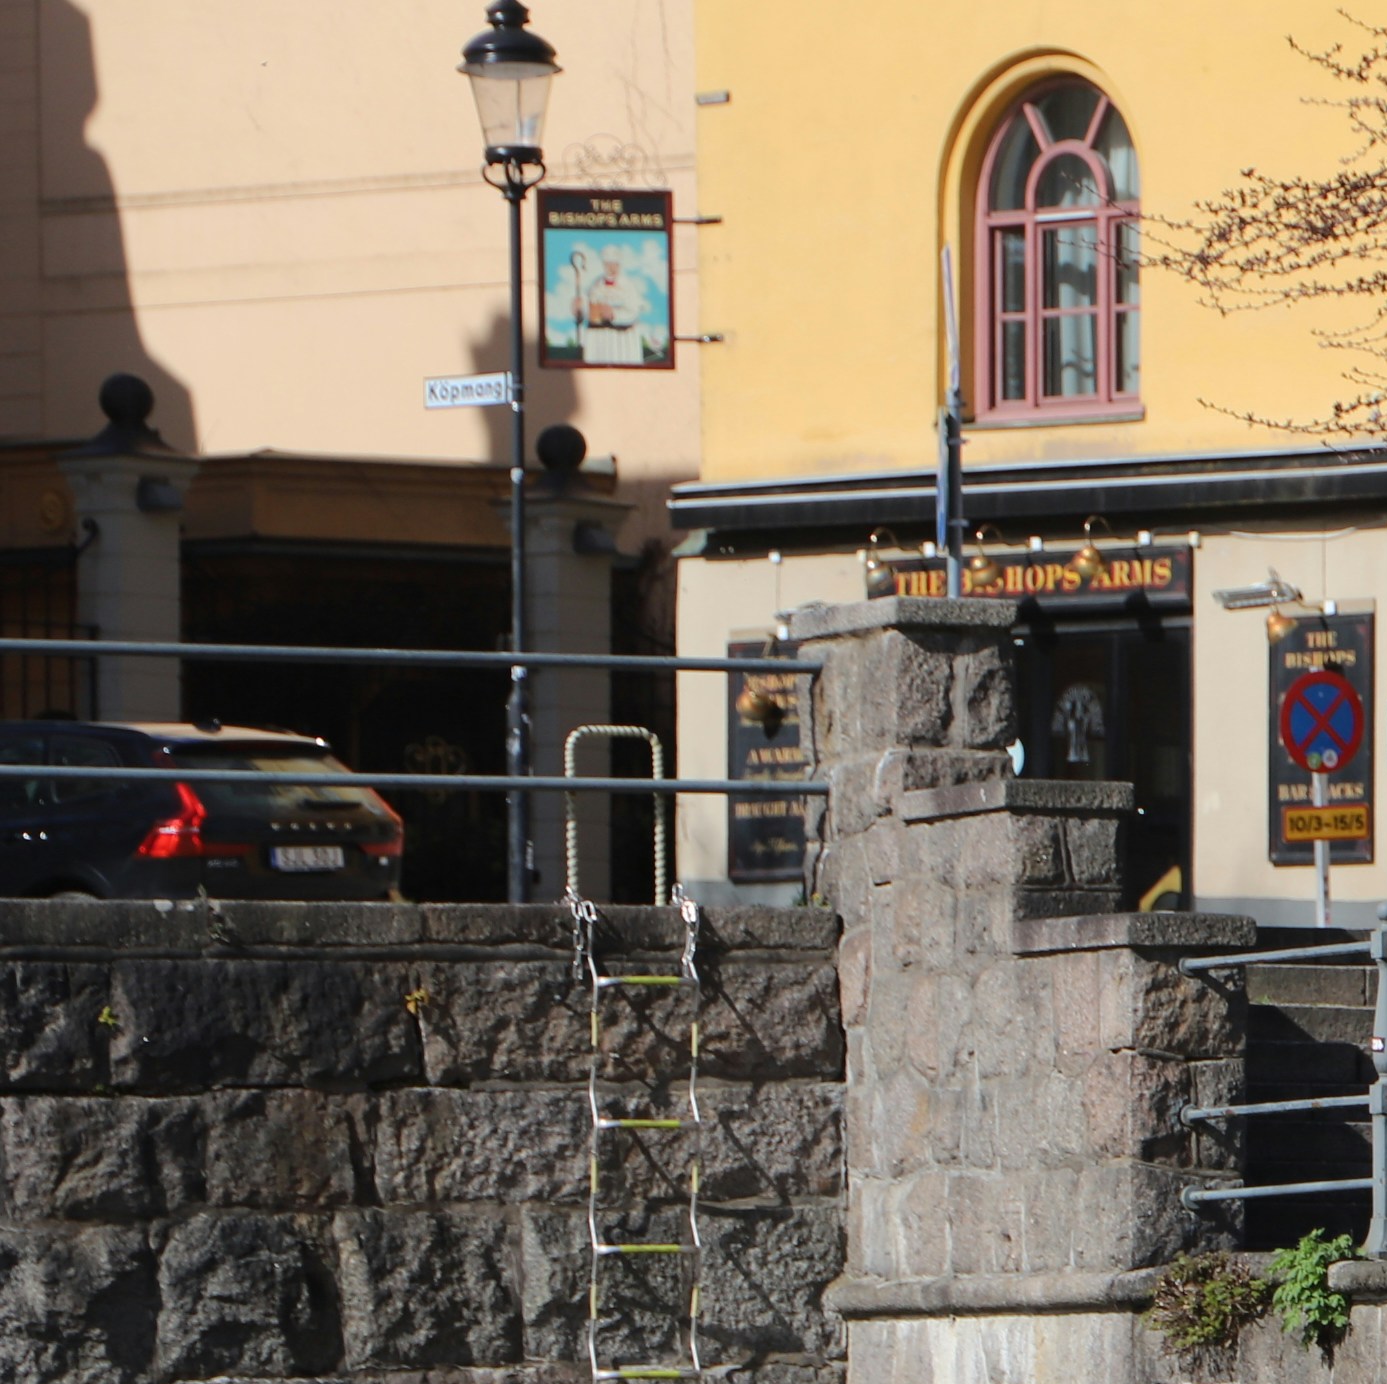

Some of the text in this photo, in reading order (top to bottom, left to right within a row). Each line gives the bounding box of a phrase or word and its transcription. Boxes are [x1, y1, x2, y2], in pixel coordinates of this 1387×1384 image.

[590, 198, 623, 213] THE
[548, 211, 664, 229] BISHOPS ARMS
[427, 380, 503, 405] Köpmang
[895, 569, 946, 597] THE
[1090, 558, 1173, 589] ARMS
[1305, 630, 1338, 649] THE
